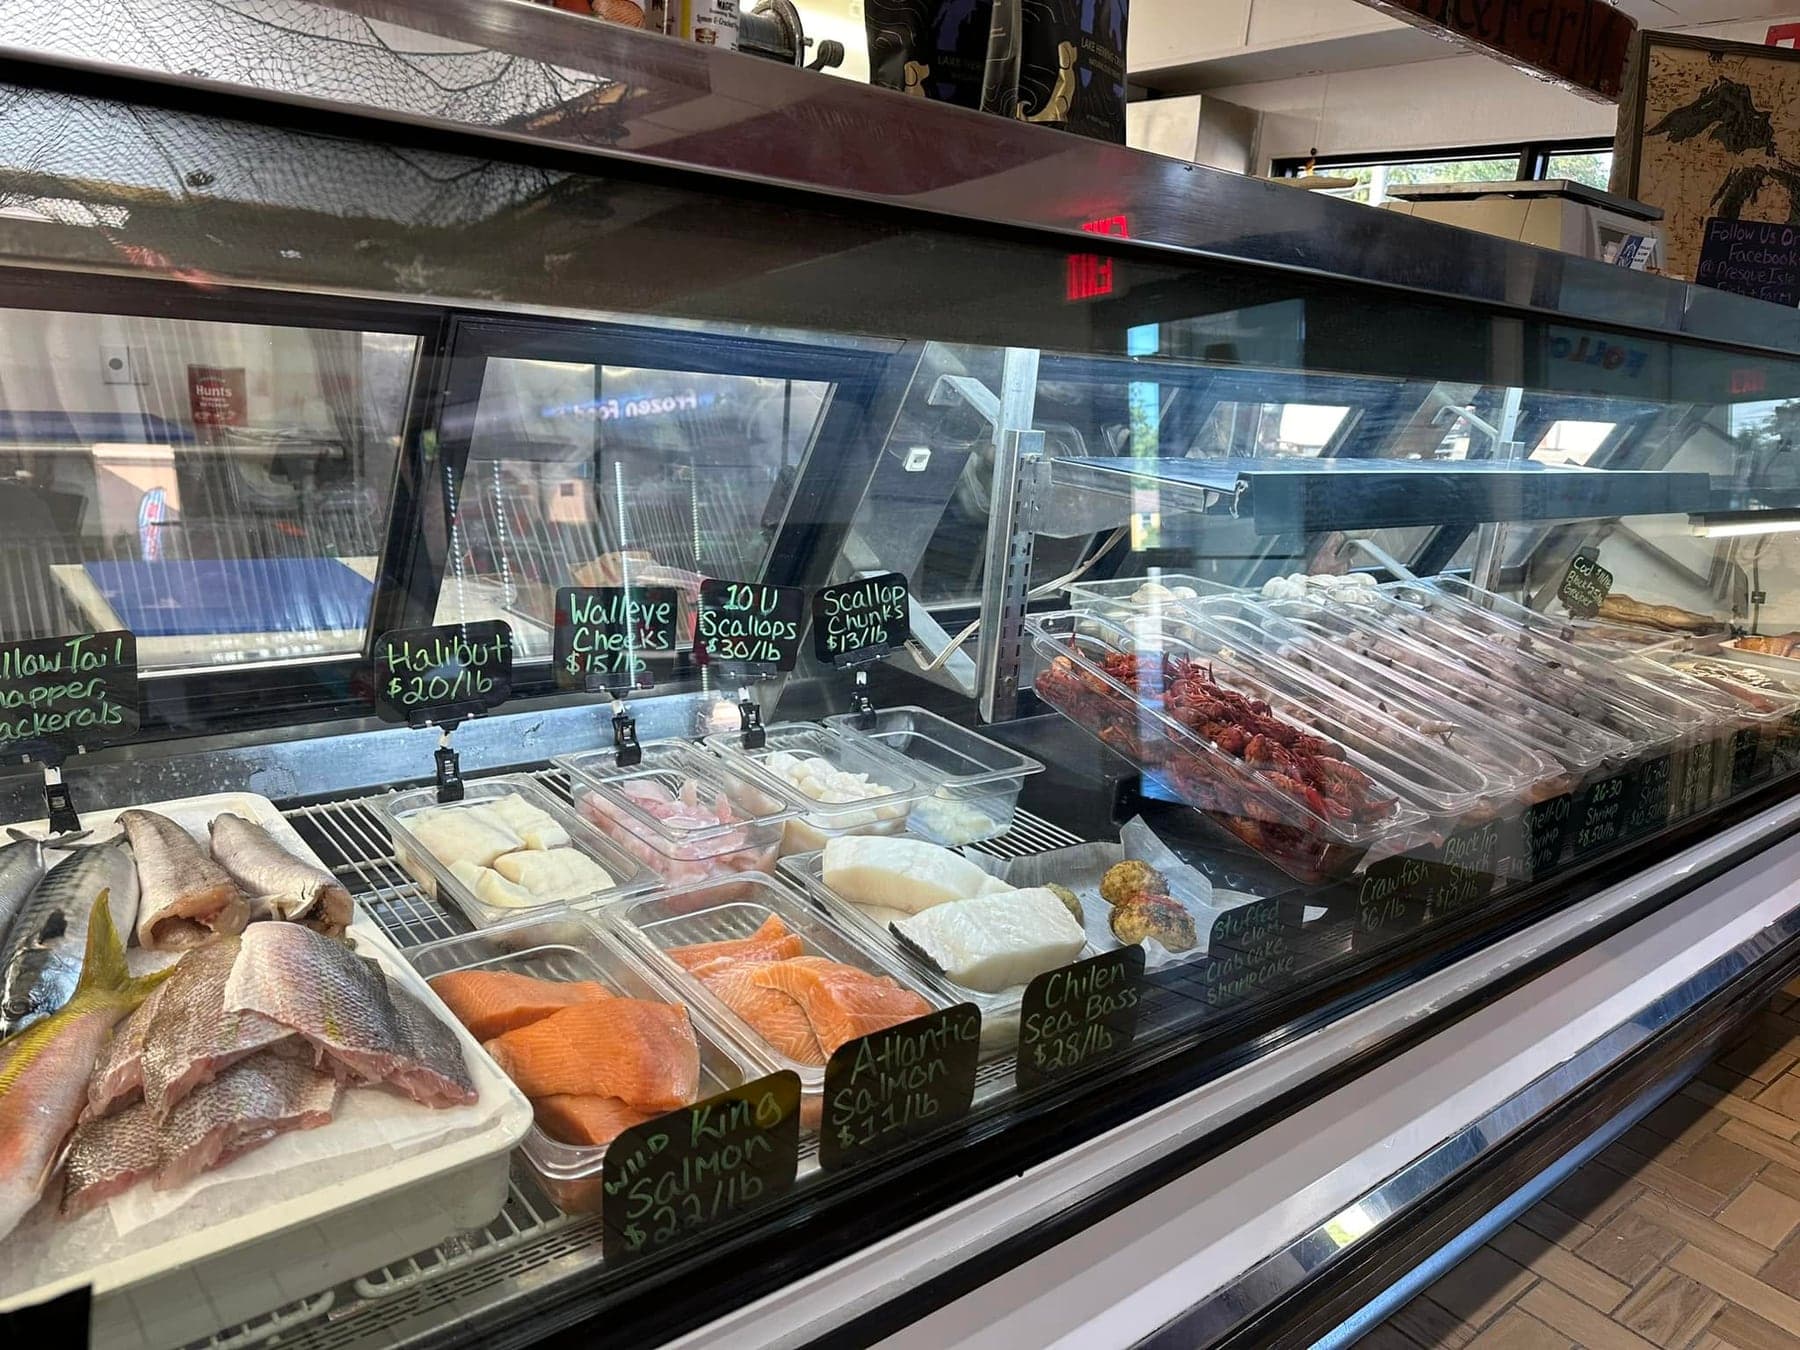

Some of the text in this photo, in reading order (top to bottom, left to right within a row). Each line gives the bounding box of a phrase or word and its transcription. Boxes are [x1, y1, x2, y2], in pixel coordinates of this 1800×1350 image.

[570, 592, 670, 626] Walleye
[722, 584, 779, 616] 10 U
[824, 583, 906, 616] Scallop
[701, 611, 798, 640] Scallops
[828, 604, 905, 635] Chunks
[65, 635, 122, 674] Tail
[387, 634, 505, 673] Halibut
[573, 626, 669, 652] Cheeks
[706, 637, 781, 661] $30/lb
[826, 628, 888, 653] $13/lb
[565, 651, 647, 676] $15/lb
[387, 669, 493, 706] $20/lb
[1045, 962, 1126, 1009] Chilen
[1025, 987, 1138, 1044] Sea Bass
[851, 1012, 979, 1084] Atlantic
[1034, 1023, 1112, 1071] $28/lb
[690, 1092, 782, 1148] King
[837, 1094, 938, 1149] $11/lb
[623, 1170, 763, 1249] $22/lb
